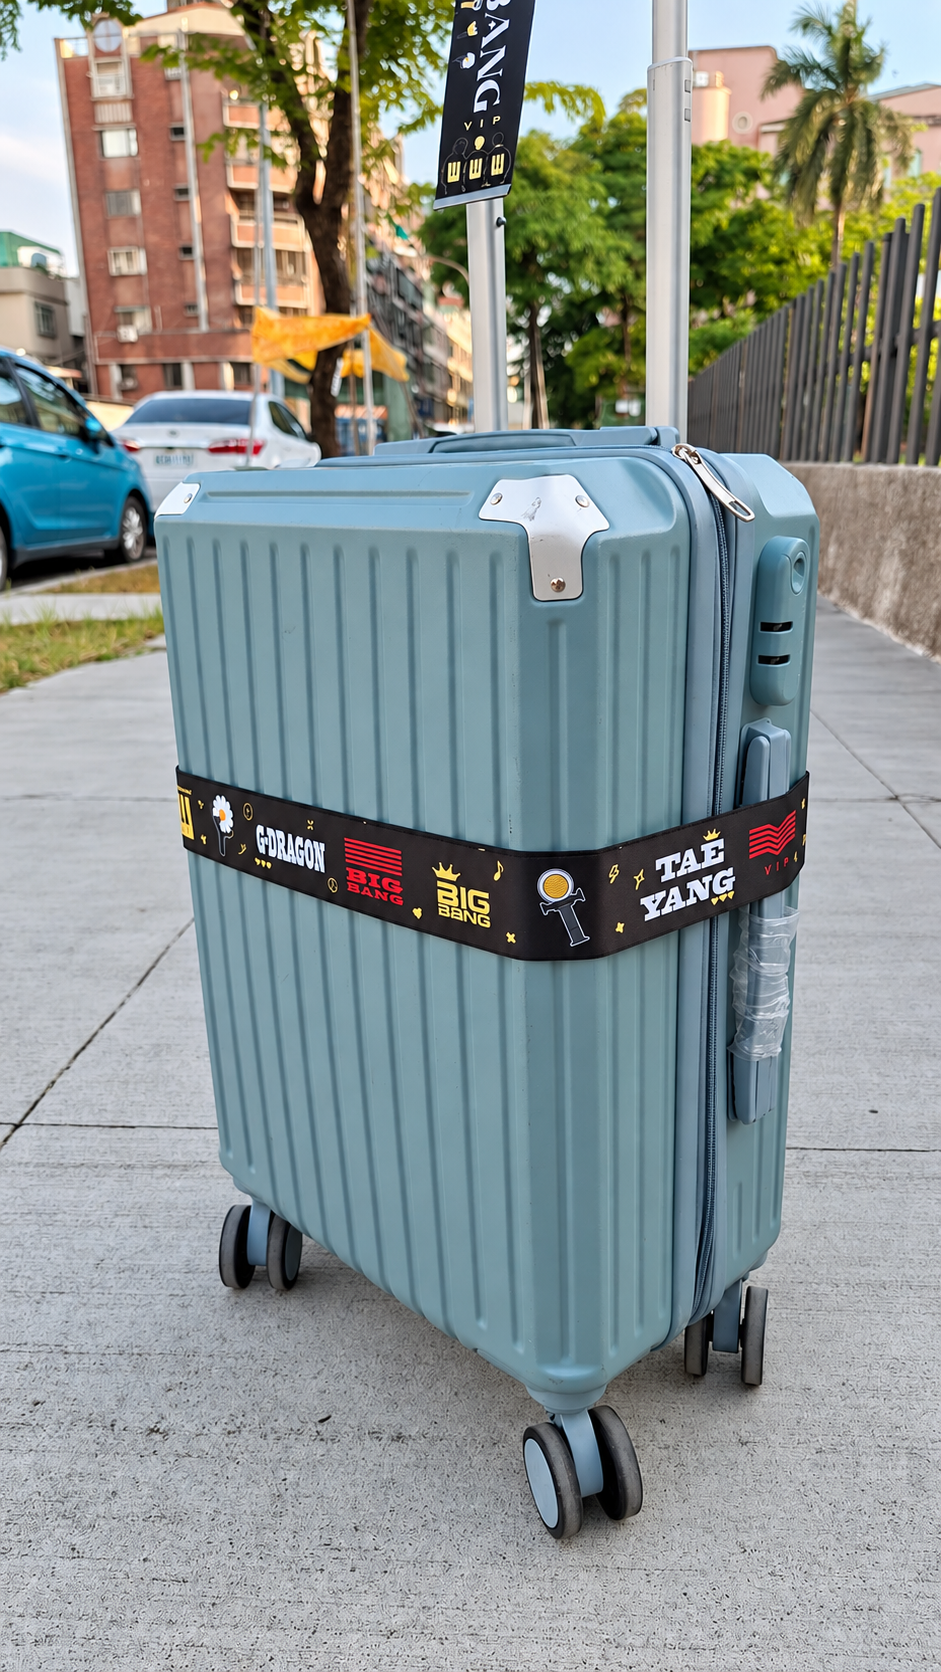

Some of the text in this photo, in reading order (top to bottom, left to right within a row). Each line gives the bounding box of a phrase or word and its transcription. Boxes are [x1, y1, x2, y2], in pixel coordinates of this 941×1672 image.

[463, 115, 501, 131] VIP
[656, 838, 725, 883] TAE
[764, 857, 789, 876] VIP
[347, 867, 404, 894] BIG
[347, 882, 404, 906] BANG
[437, 880, 491, 915] BIG
[640, 867, 736, 922] YANG
[438, 902, 491, 928] BANG
